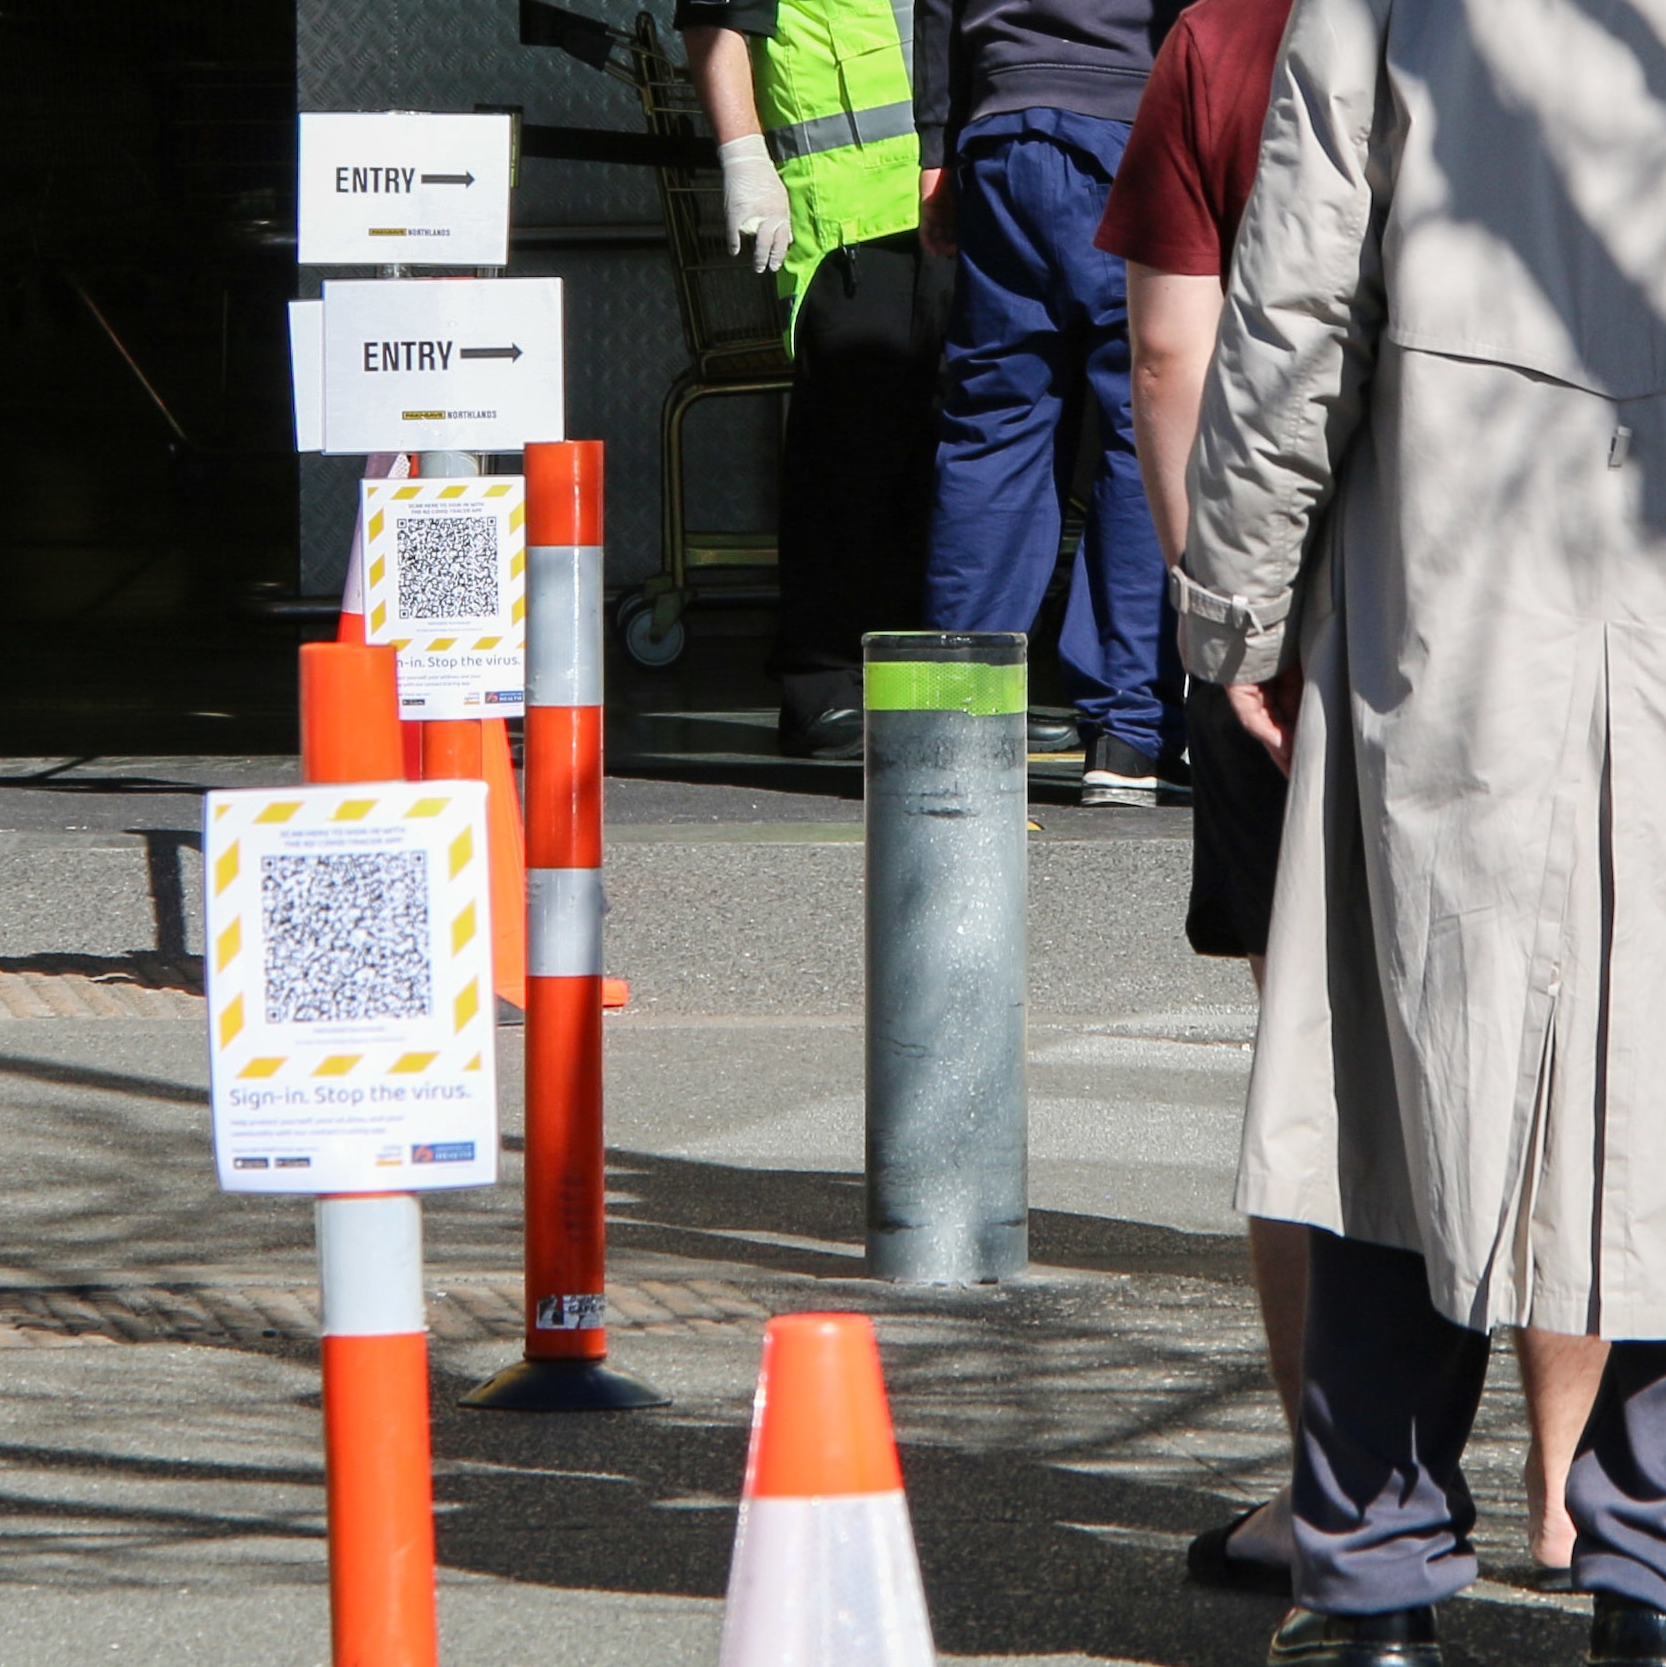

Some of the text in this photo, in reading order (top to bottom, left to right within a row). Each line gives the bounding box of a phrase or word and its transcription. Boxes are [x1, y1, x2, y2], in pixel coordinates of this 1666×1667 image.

[335, 166, 416, 194] ENTRY
[408, 228, 451, 237] NORTHLANDS
[363, 340, 453, 372] ENTRY
[447, 410, 497, 420] NORTHLANDS
[396, 654, 521, 669] n-in. Stop the virus.
[229, 1082, 473, 1110] Sign-in. Stop the virus.
